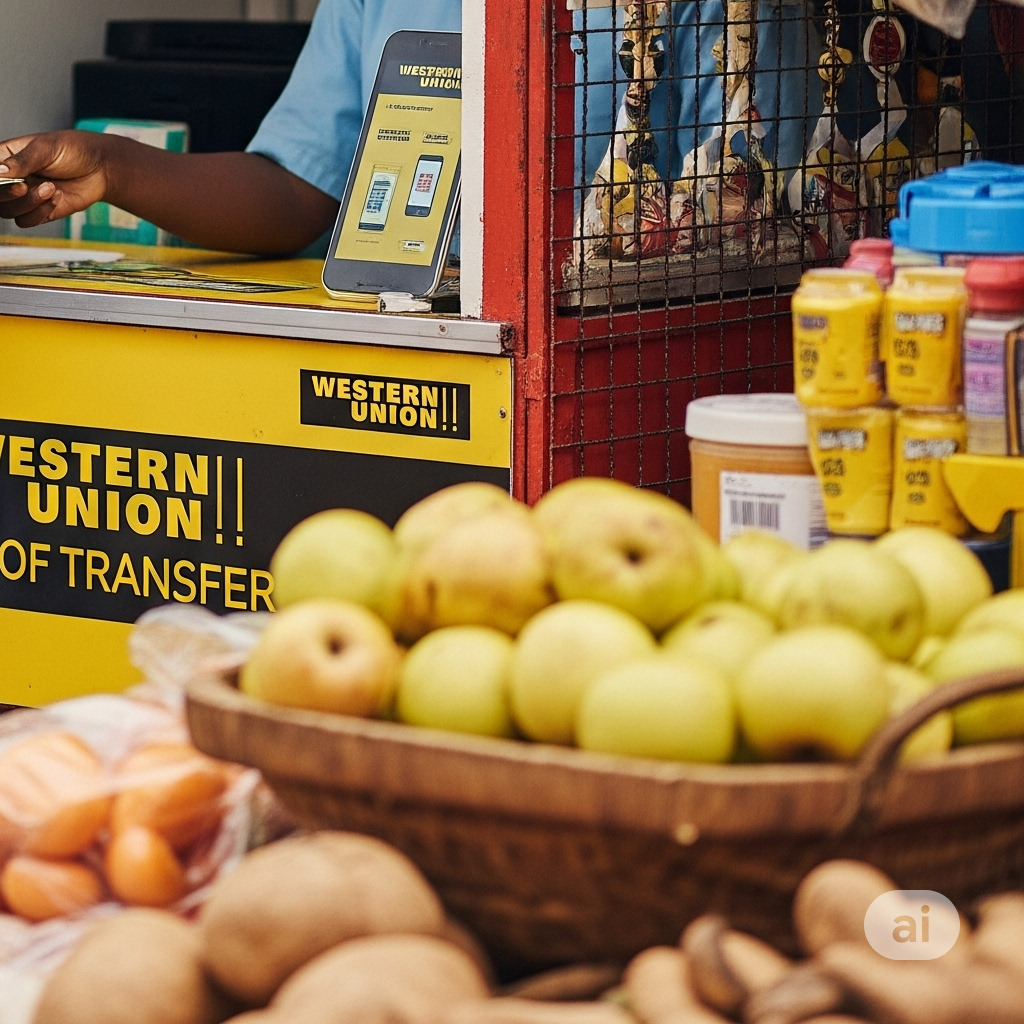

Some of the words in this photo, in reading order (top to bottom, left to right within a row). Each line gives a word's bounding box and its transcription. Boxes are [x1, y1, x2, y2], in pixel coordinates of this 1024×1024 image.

[311, 375, 439, 408] WESTERN
[350, 400, 438, 430] UNION
[26, 481, 203, 542] UNION
[59, 545, 277, 613] TRANSFER
